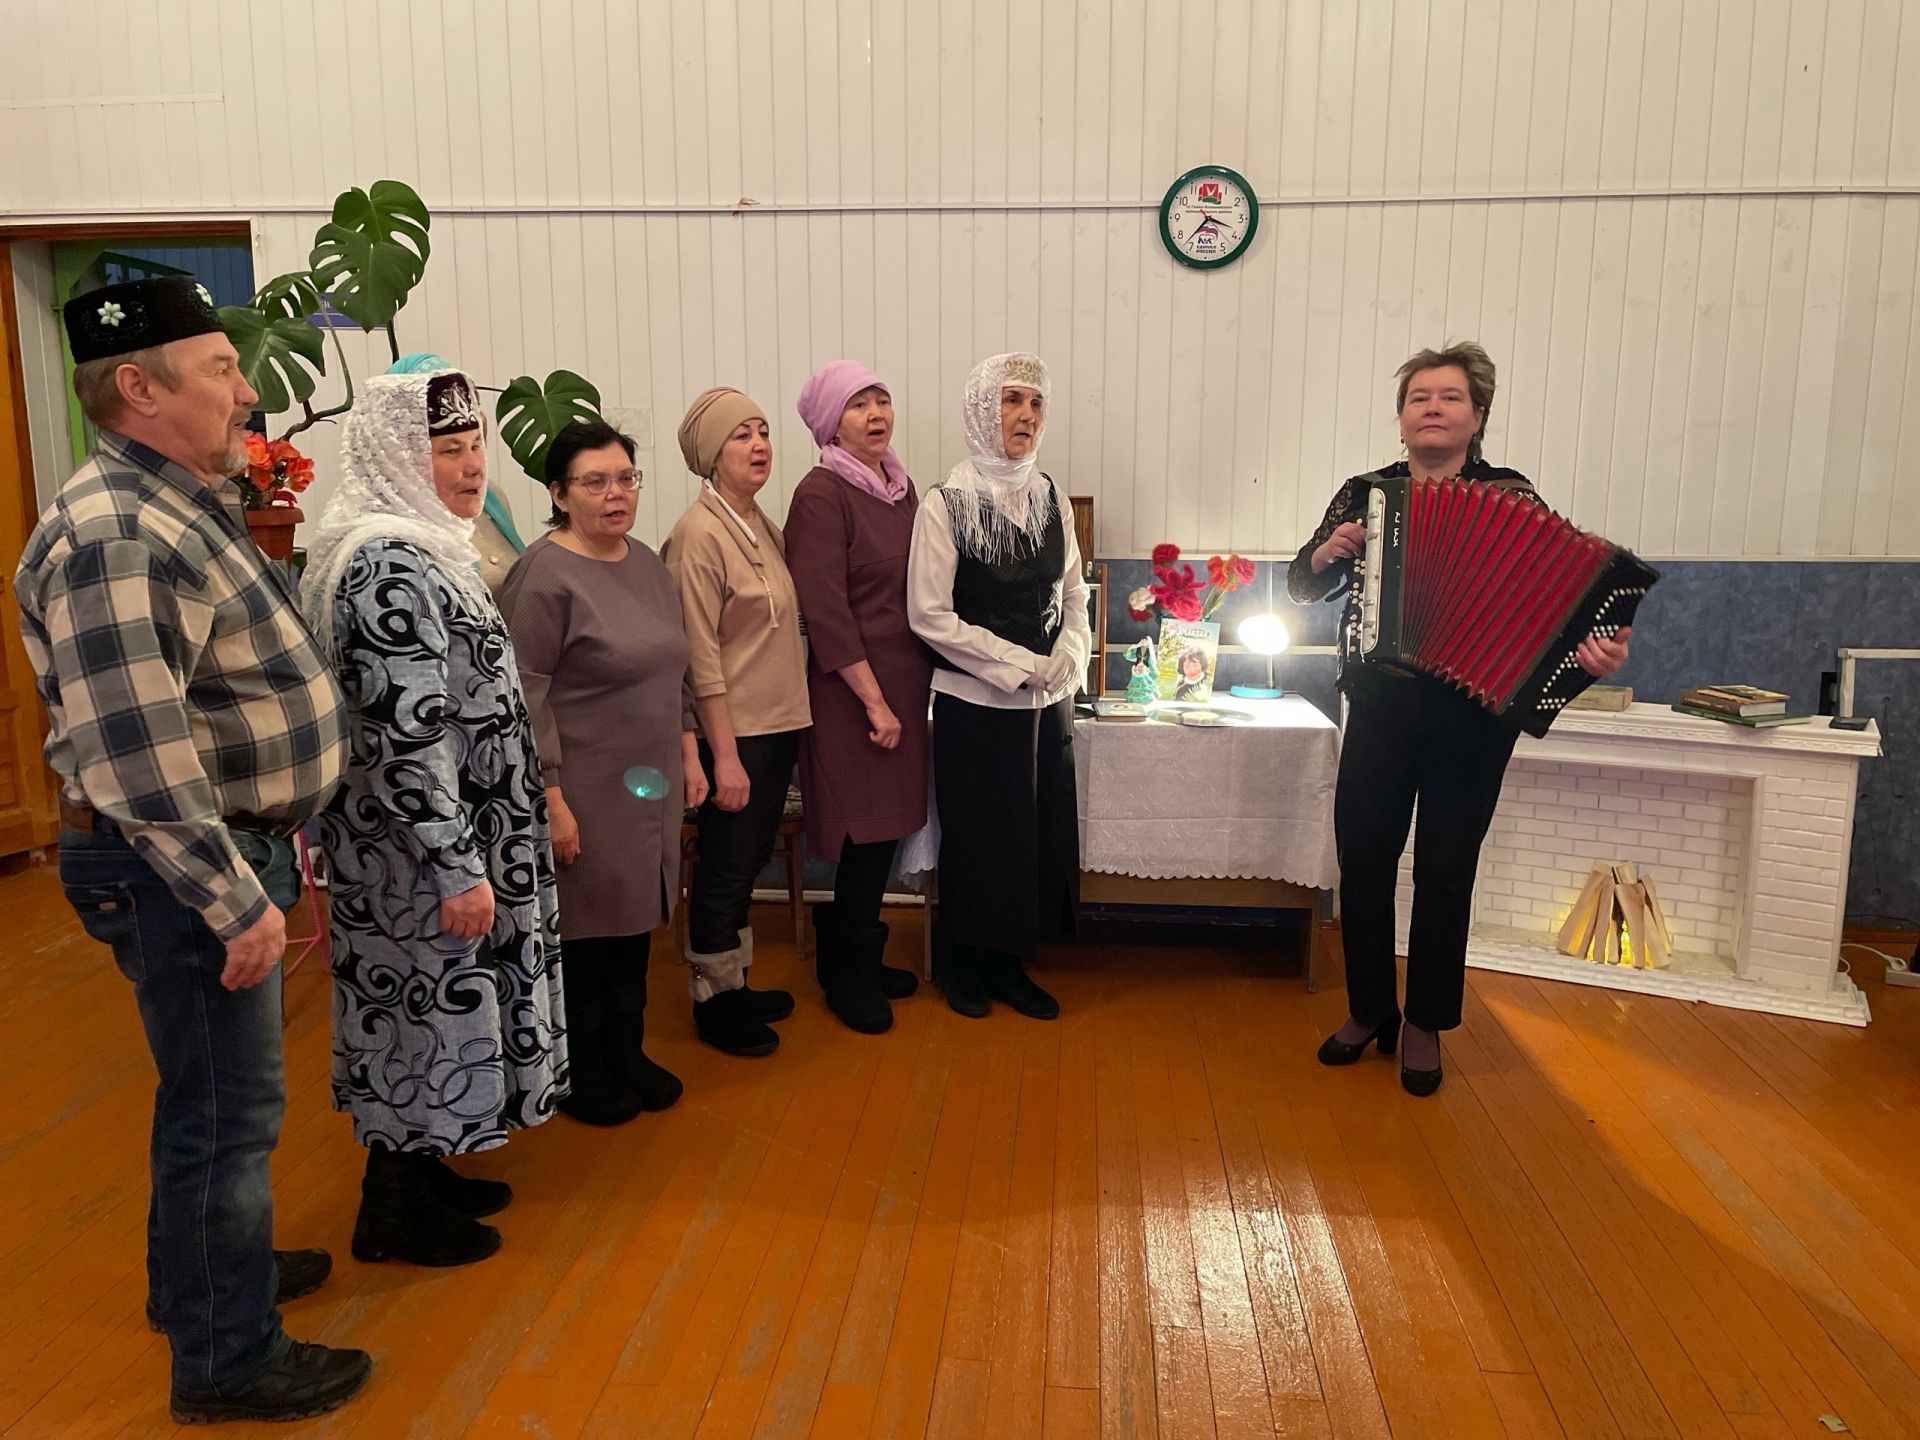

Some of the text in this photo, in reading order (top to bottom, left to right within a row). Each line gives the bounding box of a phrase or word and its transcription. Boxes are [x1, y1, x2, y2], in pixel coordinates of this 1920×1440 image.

[1190, 185, 1197, 195] 11
[1179, 196, 1188, 206] 10
[1234, 197, 1241, 207] 2
[1174, 213, 1181, 222] 9
[1238, 214, 1244, 223] 3
[1177, 230, 1184, 239] 8
[1231, 230, 1237, 240] 4
[1188, 242, 1194, 251] 7
[1220, 242, 1226, 252] 5
